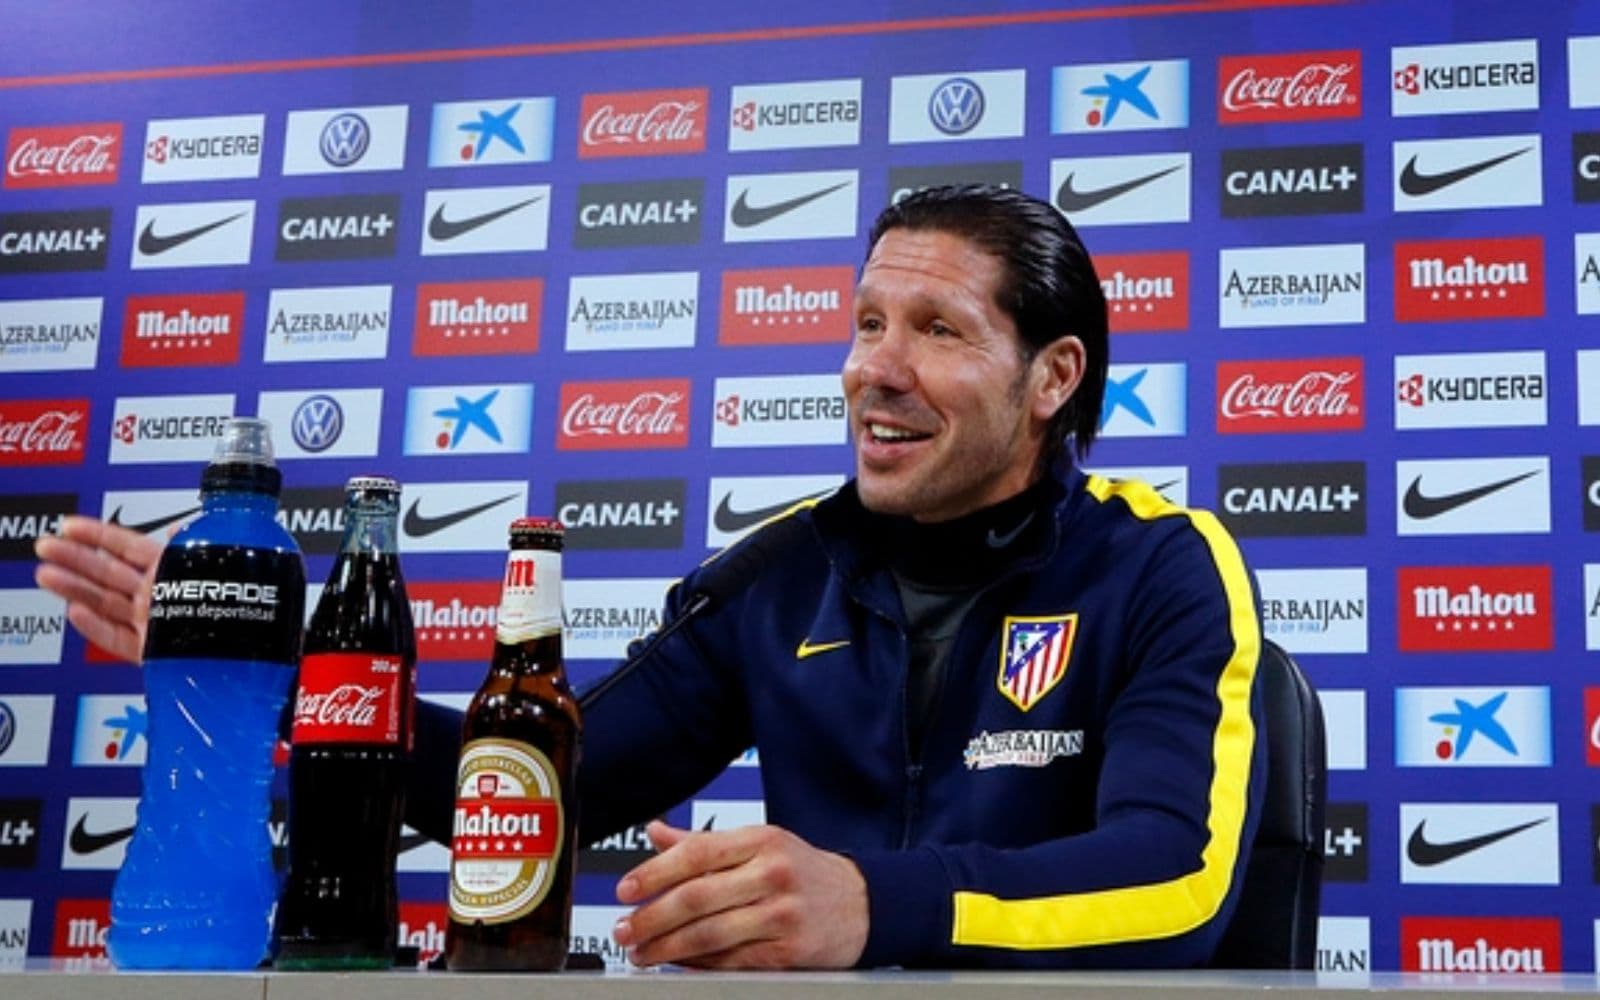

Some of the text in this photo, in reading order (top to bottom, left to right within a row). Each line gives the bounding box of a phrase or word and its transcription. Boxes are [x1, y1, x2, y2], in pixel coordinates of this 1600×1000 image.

[1225, 165, 1357, 196] CANAL+
[281, 212, 394, 242] CANAL+
[579, 198, 698, 228] CANAL+
[1102, 271, 1174, 299] ahou
[1223, 269, 1362, 305] AZERBAIJAN
[1409, 256, 1528, 289] Mahou
[428, 296, 528, 327] Mahou
[572, 296, 695, 329] AZERBAIJAN
[735, 283, 840, 314] Mahou
[136, 308, 229, 339] Mahou
[269, 308, 387, 342] AZERBAIJAN
[559, 499, 679, 528] CANAL+
[1223, 484, 1359, 514] CANAL+
[1262, 599, 1364, 632] ERBAIJAN
[1414, 584, 1536, 618] Mahou
